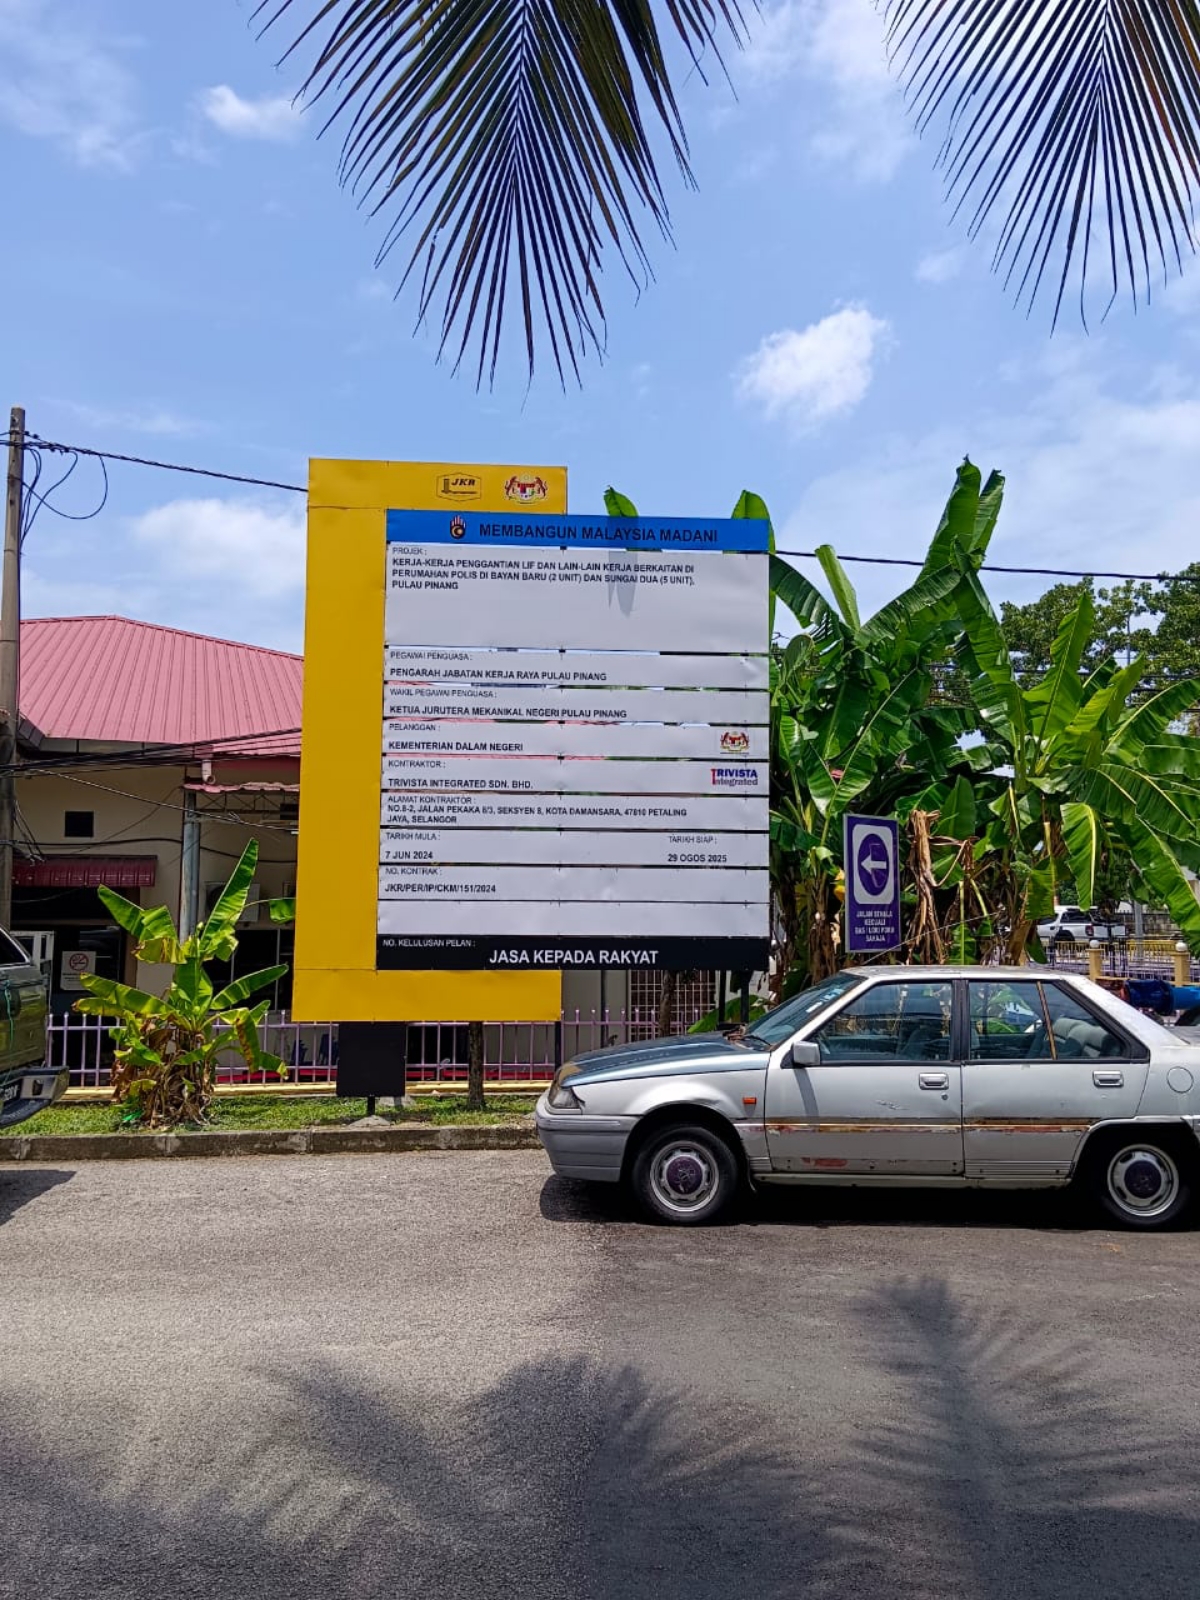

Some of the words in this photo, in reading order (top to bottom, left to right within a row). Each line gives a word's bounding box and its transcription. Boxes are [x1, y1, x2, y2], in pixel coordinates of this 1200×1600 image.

[480, 524, 576, 539] MEMBANGUN
[582, 527, 656, 540] MALAYSIA
[660, 530, 718, 542] MADANI
[392, 558, 454, 567] KERJA-KERJA
[456, 560, 519, 569] PENGGANTIAN
[522, 561, 534, 569] LIF
[537, 561, 556, 570] DAN
[558, 562, 600, 571] LAIN-LAIN
[634, 564, 683, 573] BERKAITAN
[685, 565, 694, 573] DI
[392, 569, 449, 578] PERUMAHAN
[451, 571, 477, 579] POLIS
[480, 571, 488, 580] DI
[490, 572, 520, 580] BAYAN
[522, 573, 546, 581] BARU
[549, 573, 556, 582] (2
[559, 573, 581, 583] UNIT)
[584, 574, 601, 582] DAN
[604, 574, 638, 583] SUNGAI
[660, 576, 668, 585] (5
[392, 580, 422, 589] PULAU
[425, 581, 458, 590] PINANG
[390, 651, 426, 659] PEGAWAI
[427, 652, 469, 660] PENGUASA
[390, 669, 440, 677] PENGARAH
[442, 670, 483, 678] JABATAN
[485, 670, 514, 678] KERJA
[517, 671, 539, 679] RAYA
[542, 672, 570, 680] PULAU
[573, 672, 607, 681] PINANG
[415, 689, 450, 697] PEGAWAI
[452, 689, 493, 698] PENGUASA
[390, 706, 420, 714] KETUA
[422, 706, 469, 715] JURUTERA
[472, 707, 523, 716] MEKANIKAL
[526, 708, 559, 716] NEGERI
[594, 710, 627, 718] PINANG
[389, 741, 453, 750] KEMENTERIAN
[456, 742, 487, 750] DALAM
[489, 742, 523, 751] NEGERI
[388, 760, 441, 768] KONTRAKTOR
[711, 769, 758, 779] TRIVISTA
[388, 779, 428, 787] TRIVISTA
[430, 779, 486, 788] INTEGRATED
[488, 780, 509, 788] SDN.
[512, 780, 533, 789] BHD.
[497, 806, 535, 815] SEKSYEN
[546, 807, 567, 815] KOTA
[387, 815, 409, 823] JAYA,
[412, 815, 457, 823] SELANGOR
[385, 851, 390, 859] 7
[393, 851, 410, 859] JUN
[413, 851, 433, 859] 2024
[668, 854, 678, 862] 29
[680, 854, 705, 862] OGOS
[708, 854, 727, 863] 2025
[489, 950, 530, 964] JASA
[533, 950, 595, 964] KEPADA
[599, 950, 658, 964] RAKYAT
